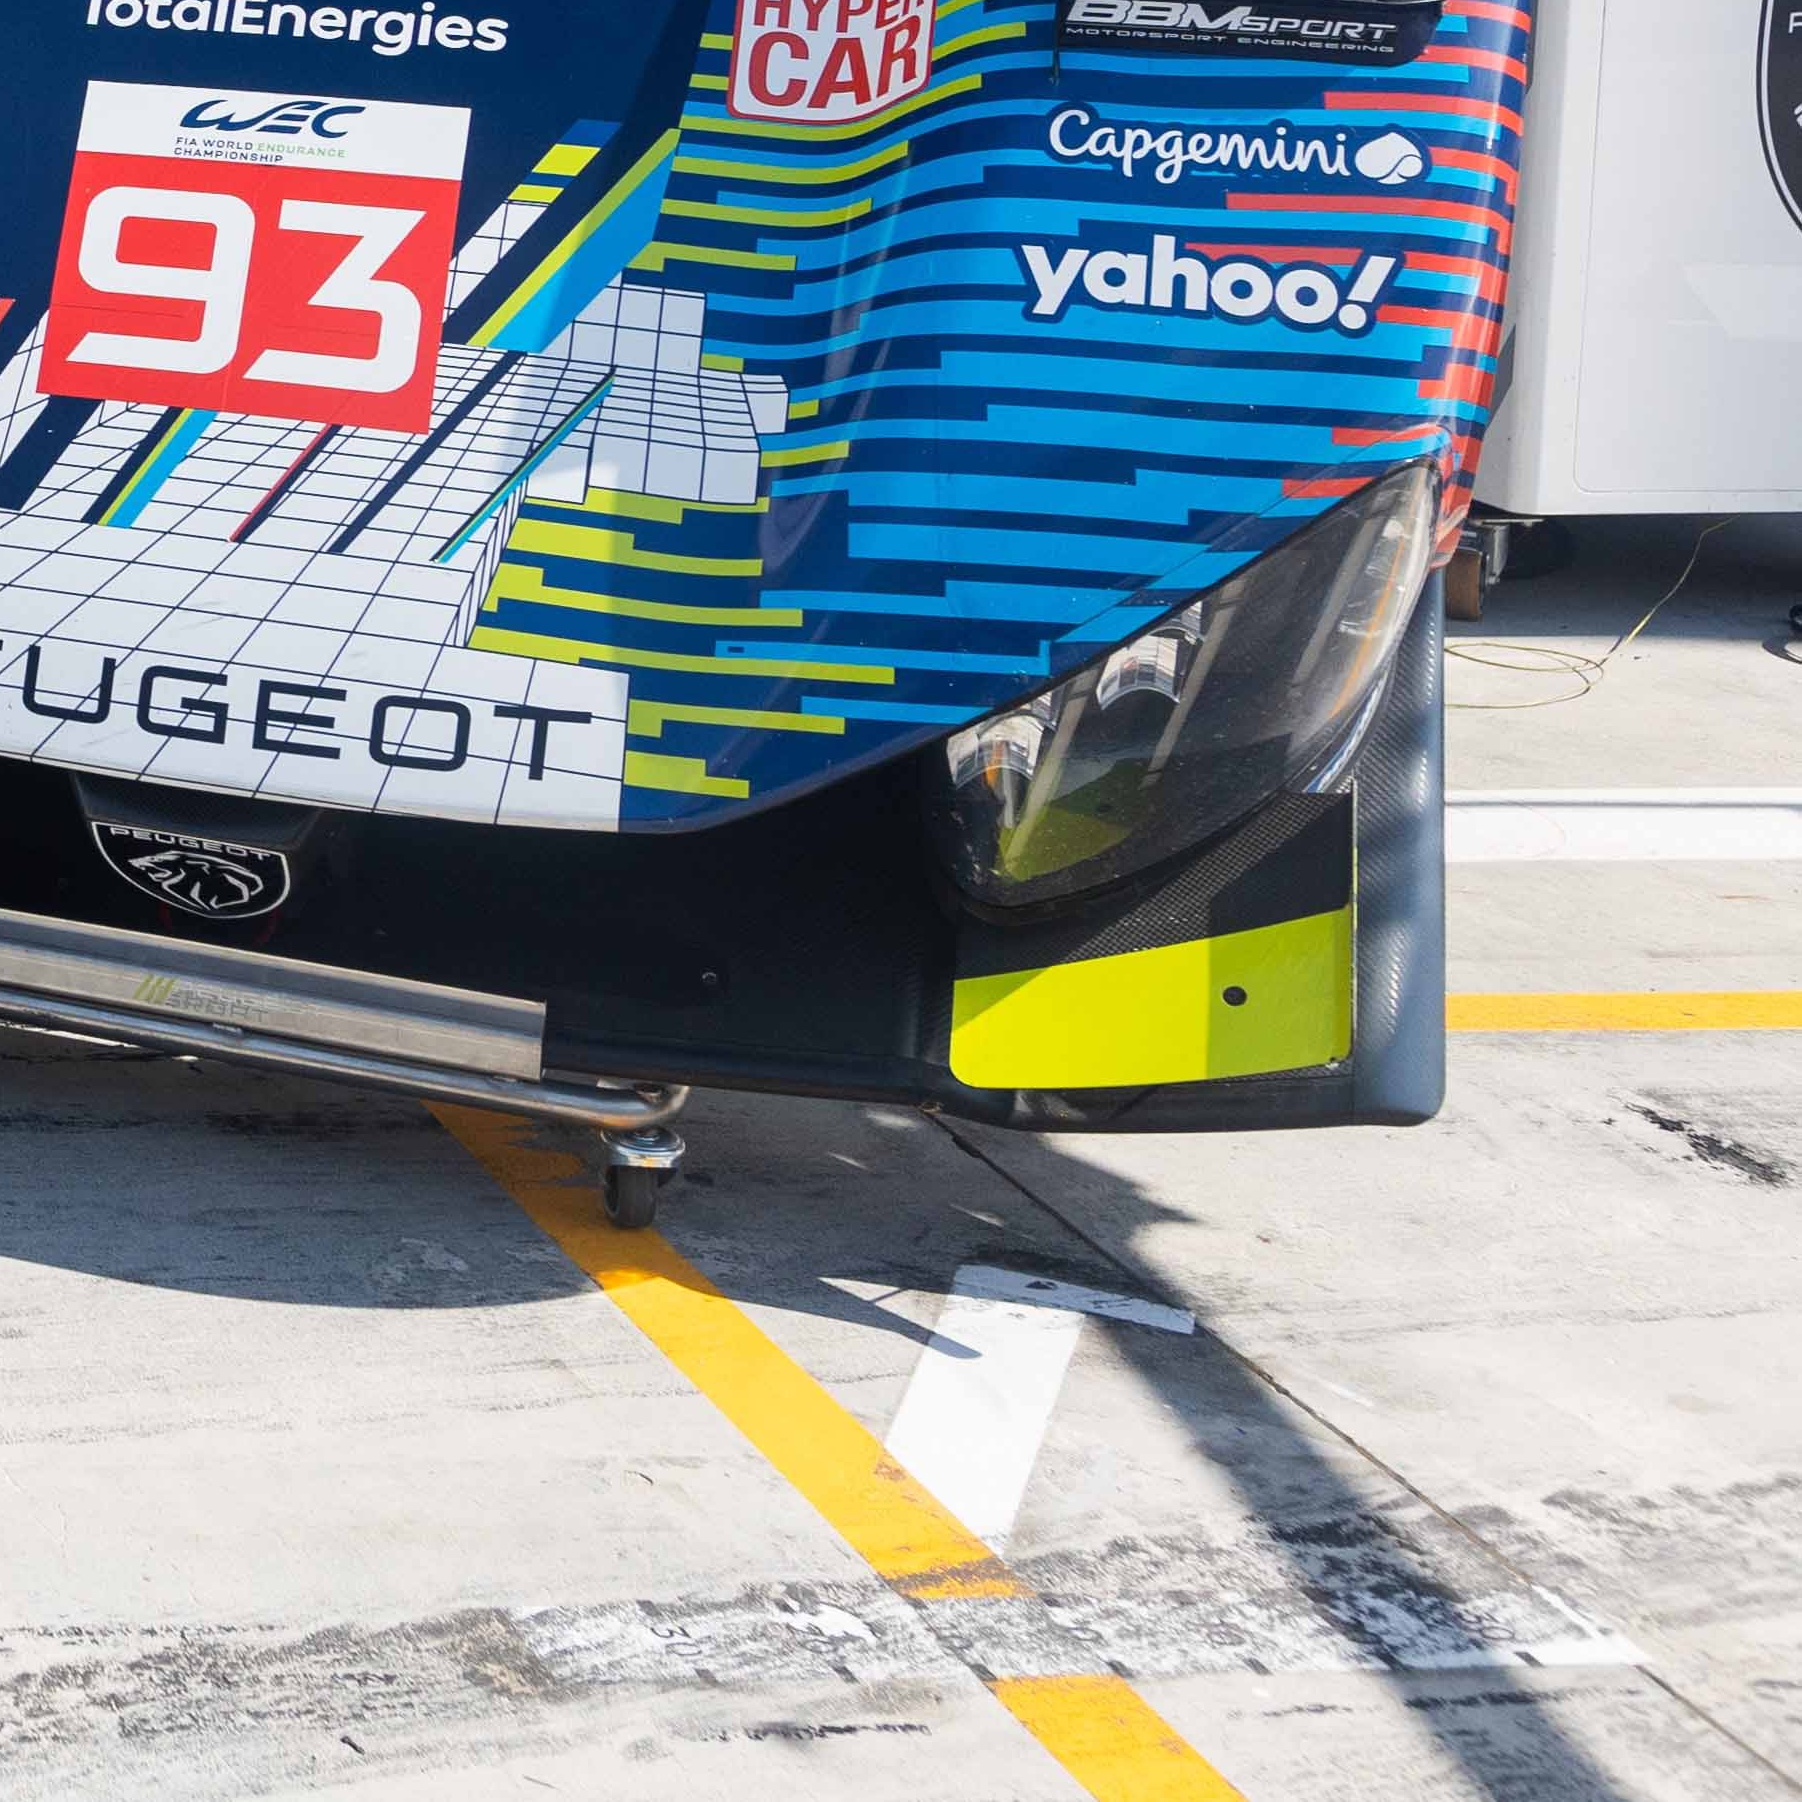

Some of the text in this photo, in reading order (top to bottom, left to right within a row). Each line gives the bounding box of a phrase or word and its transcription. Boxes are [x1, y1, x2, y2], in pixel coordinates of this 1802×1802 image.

[1065, 27, 1395, 54] MOTORSPORT ENGINEERING
[748, 14, 922, 110] CAR
[179, 99, 367, 140] WEC
[173, 147, 284, 164] CHAMPIONSHIP
[175, 136, 347, 159] FIA WORLD ENDURANCE
[1048, 108, 1349, 186] Capgemini
[65, 185, 429, 395] 93
[1020, 233, 1398, 333] yahoo!
[109, 826, 272, 862] PEUGEOT
